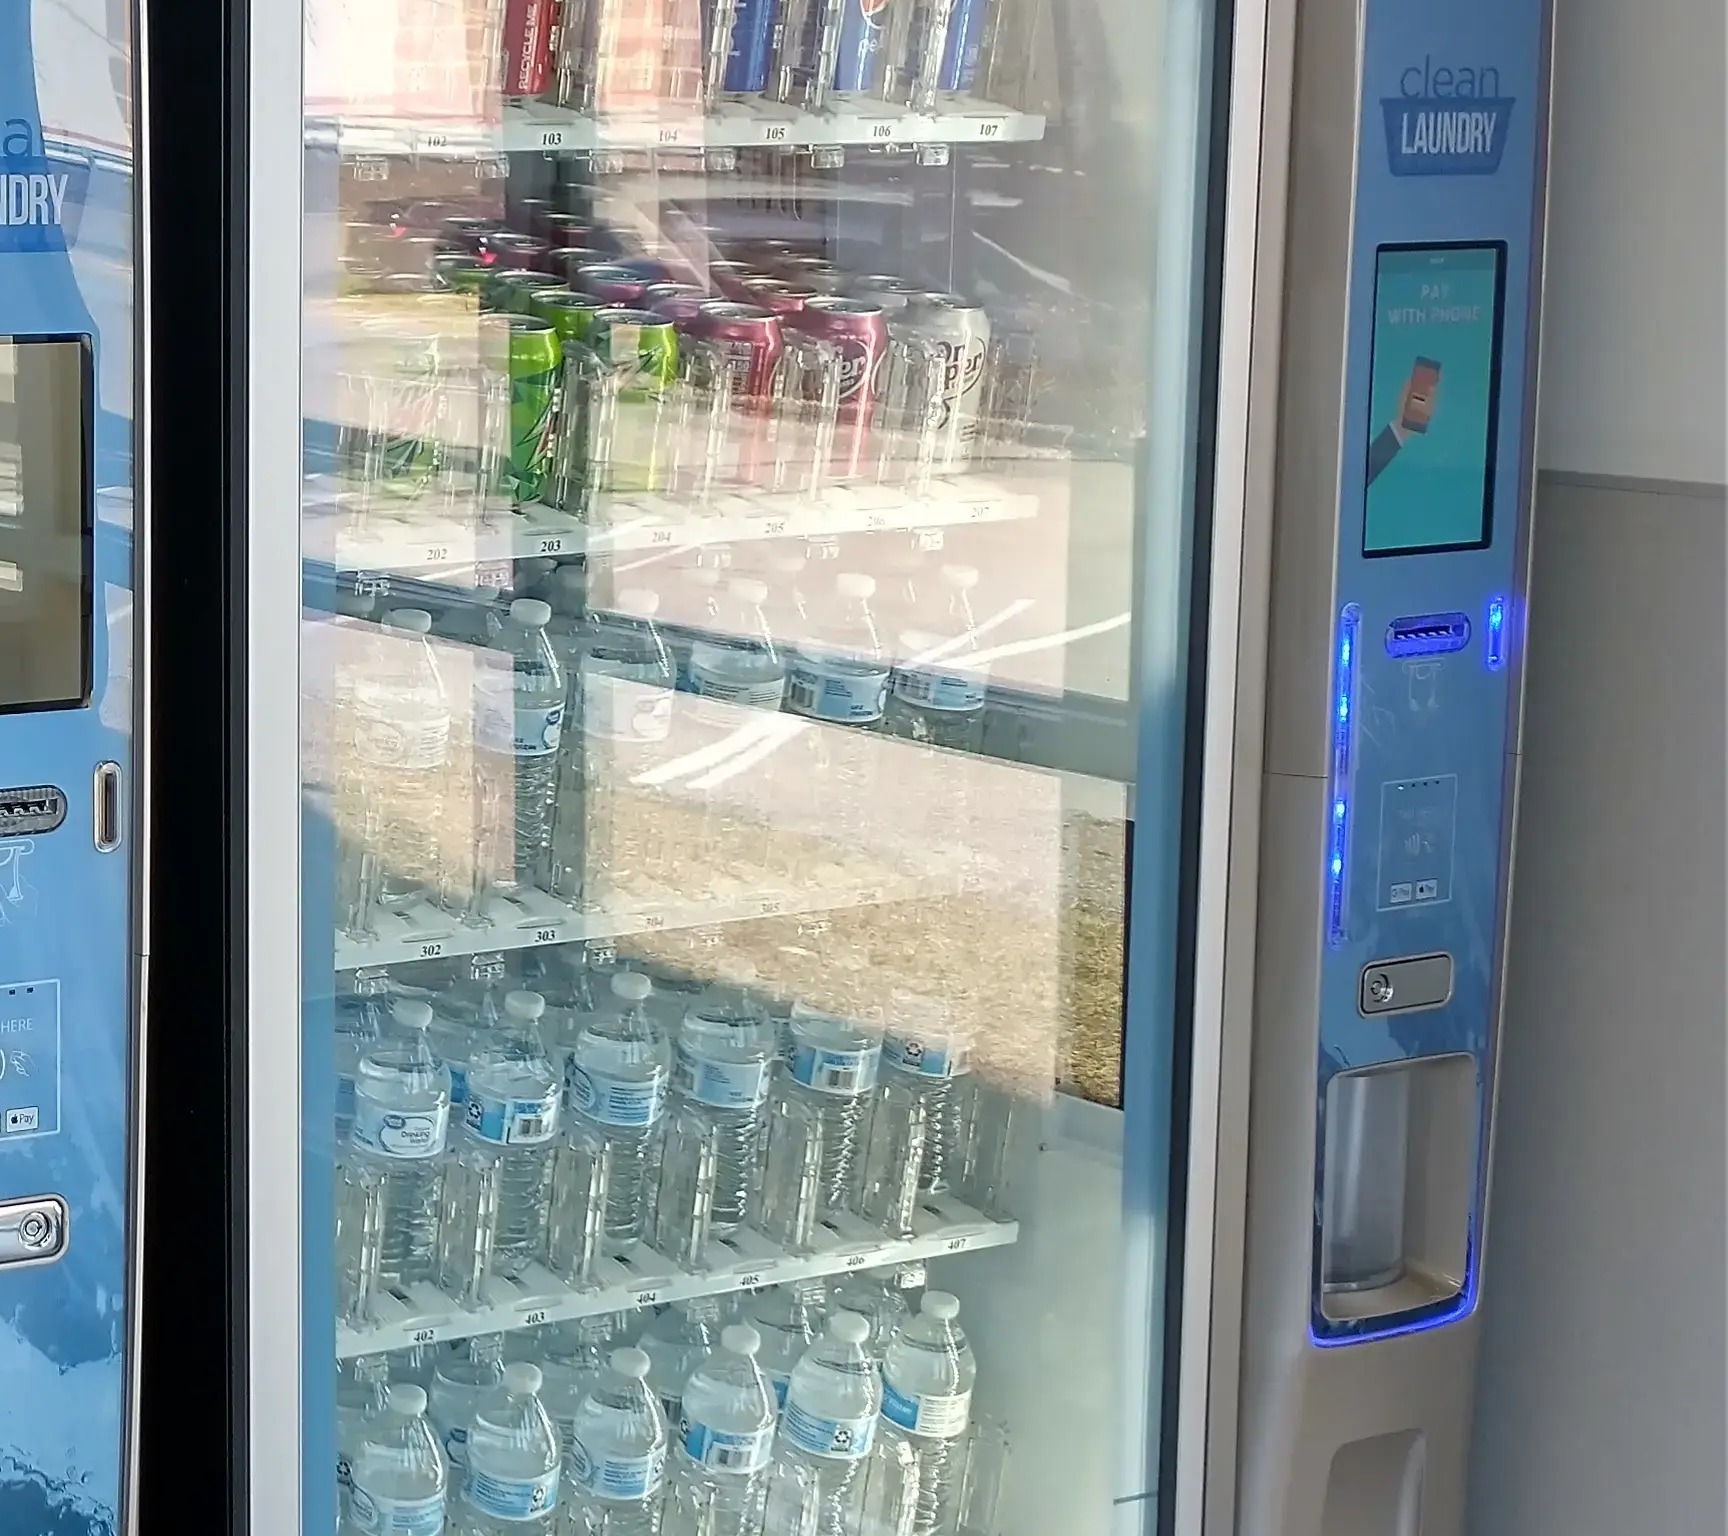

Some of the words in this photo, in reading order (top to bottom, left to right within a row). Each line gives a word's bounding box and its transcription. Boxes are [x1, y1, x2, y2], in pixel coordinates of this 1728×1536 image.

[525, 4, 538, 27] ME
[518, 28, 535, 90] RECYCLE
[1400, 54, 1499, 99] clean
[658, 128, 678, 142] 104
[765, 127, 785, 141] 105
[872, 125, 891, 138] 106
[980, 124, 999, 137] 107
[1401, 112, 1496, 156] LAUNDRY
[542, 133, 562, 146] 103
[1420, 284, 1450, 300] PAY
[540, 540, 562, 553] 203
[427, 548, 448, 561] 202
[535, 929, 556, 943] 303
[420, 944, 441, 957] 302
[1, 1017, 33, 1034] HERE
[19, 1113, 34, 1125] Pay
[947, 1238, 967, 1251] 407
[846, 1255, 866, 1267] 406
[739, 1274, 760, 1287] 405
[635, 1292, 658, 1305] 404
[524, 1311, 546, 1324] 403
[414, 1329, 435, 1343] 402
